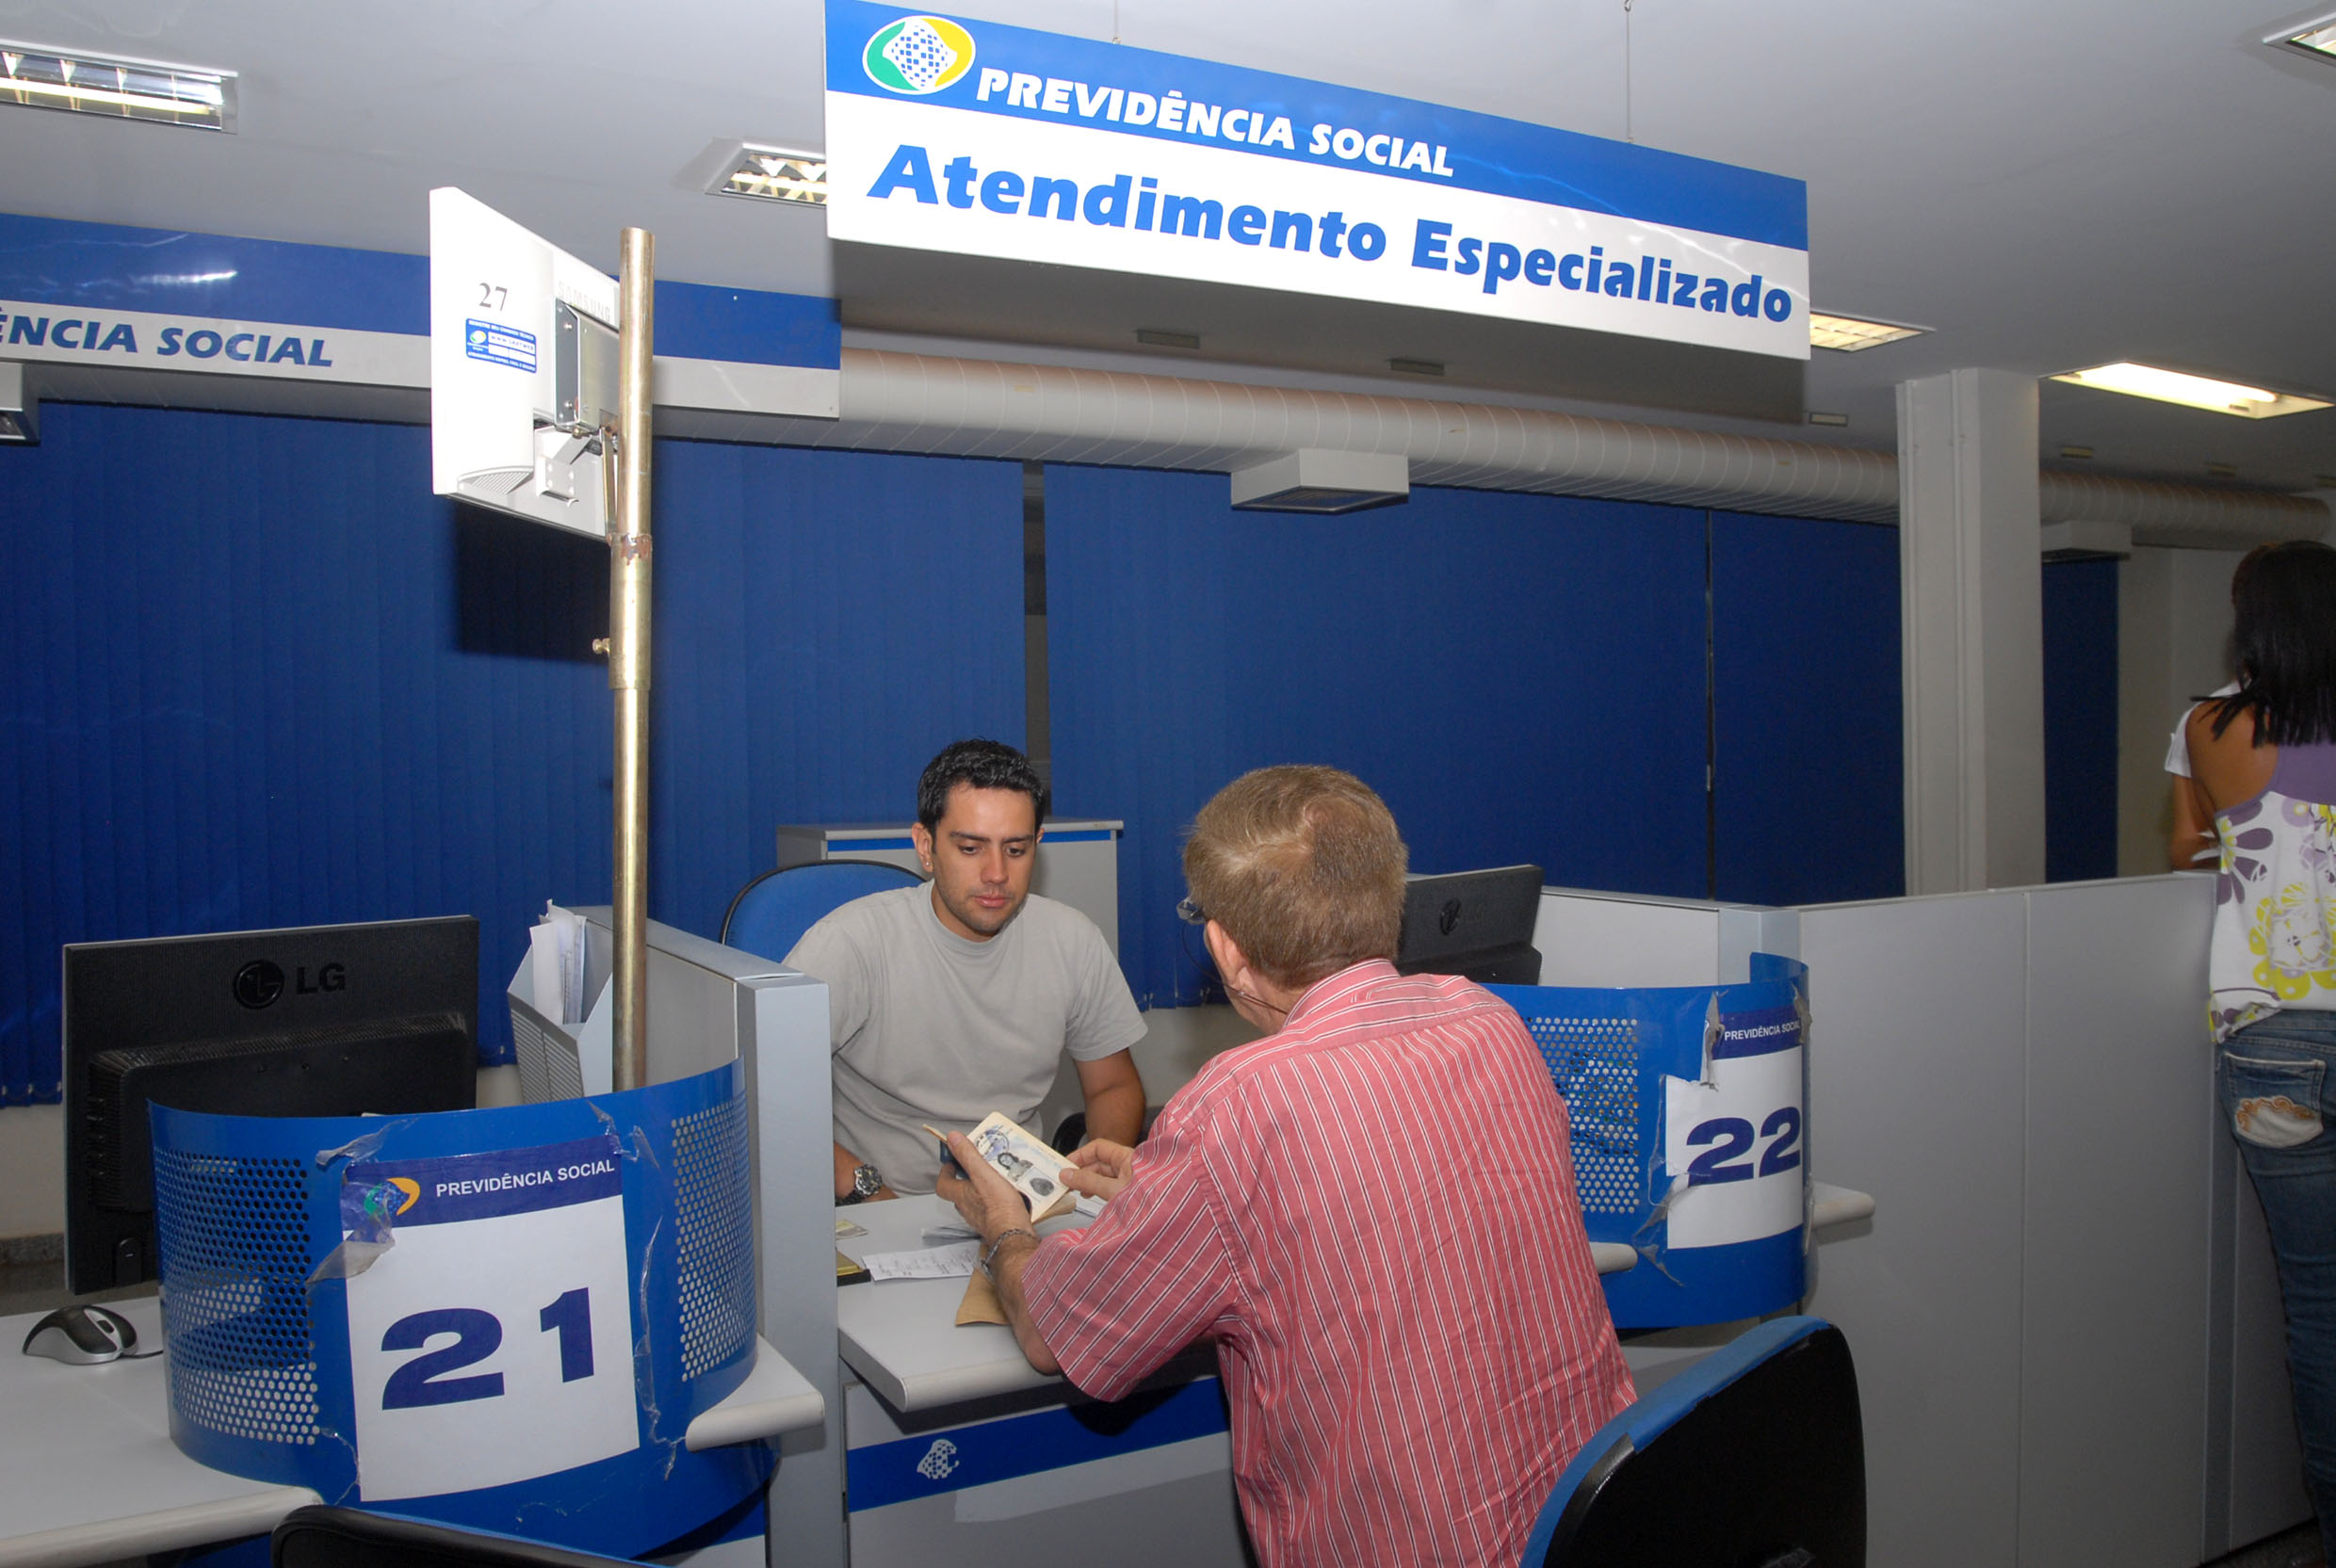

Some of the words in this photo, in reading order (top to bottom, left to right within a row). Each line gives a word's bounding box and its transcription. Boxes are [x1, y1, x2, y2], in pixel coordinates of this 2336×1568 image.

[975, 67, 1295, 151] PREVIDÊNCIA
[1309, 123, 1454, 177] SOCIAL
[866, 144, 1387, 262] Atendimento
[1411, 218, 1793, 323] Especializado
[478, 282, 508, 312] 27
[156, 327, 333, 367] SOCIAL
[296, 962, 346, 994] LG
[1724, 1024, 1780, 1041] PREVIDÊNCIA
[1686, 1106, 1802, 1188] 22
[436, 1170, 554, 1198] PREVIDÊNCIA
[558, 1158, 615, 1181] SOCIAL
[381, 1286, 595, 1411] 21
